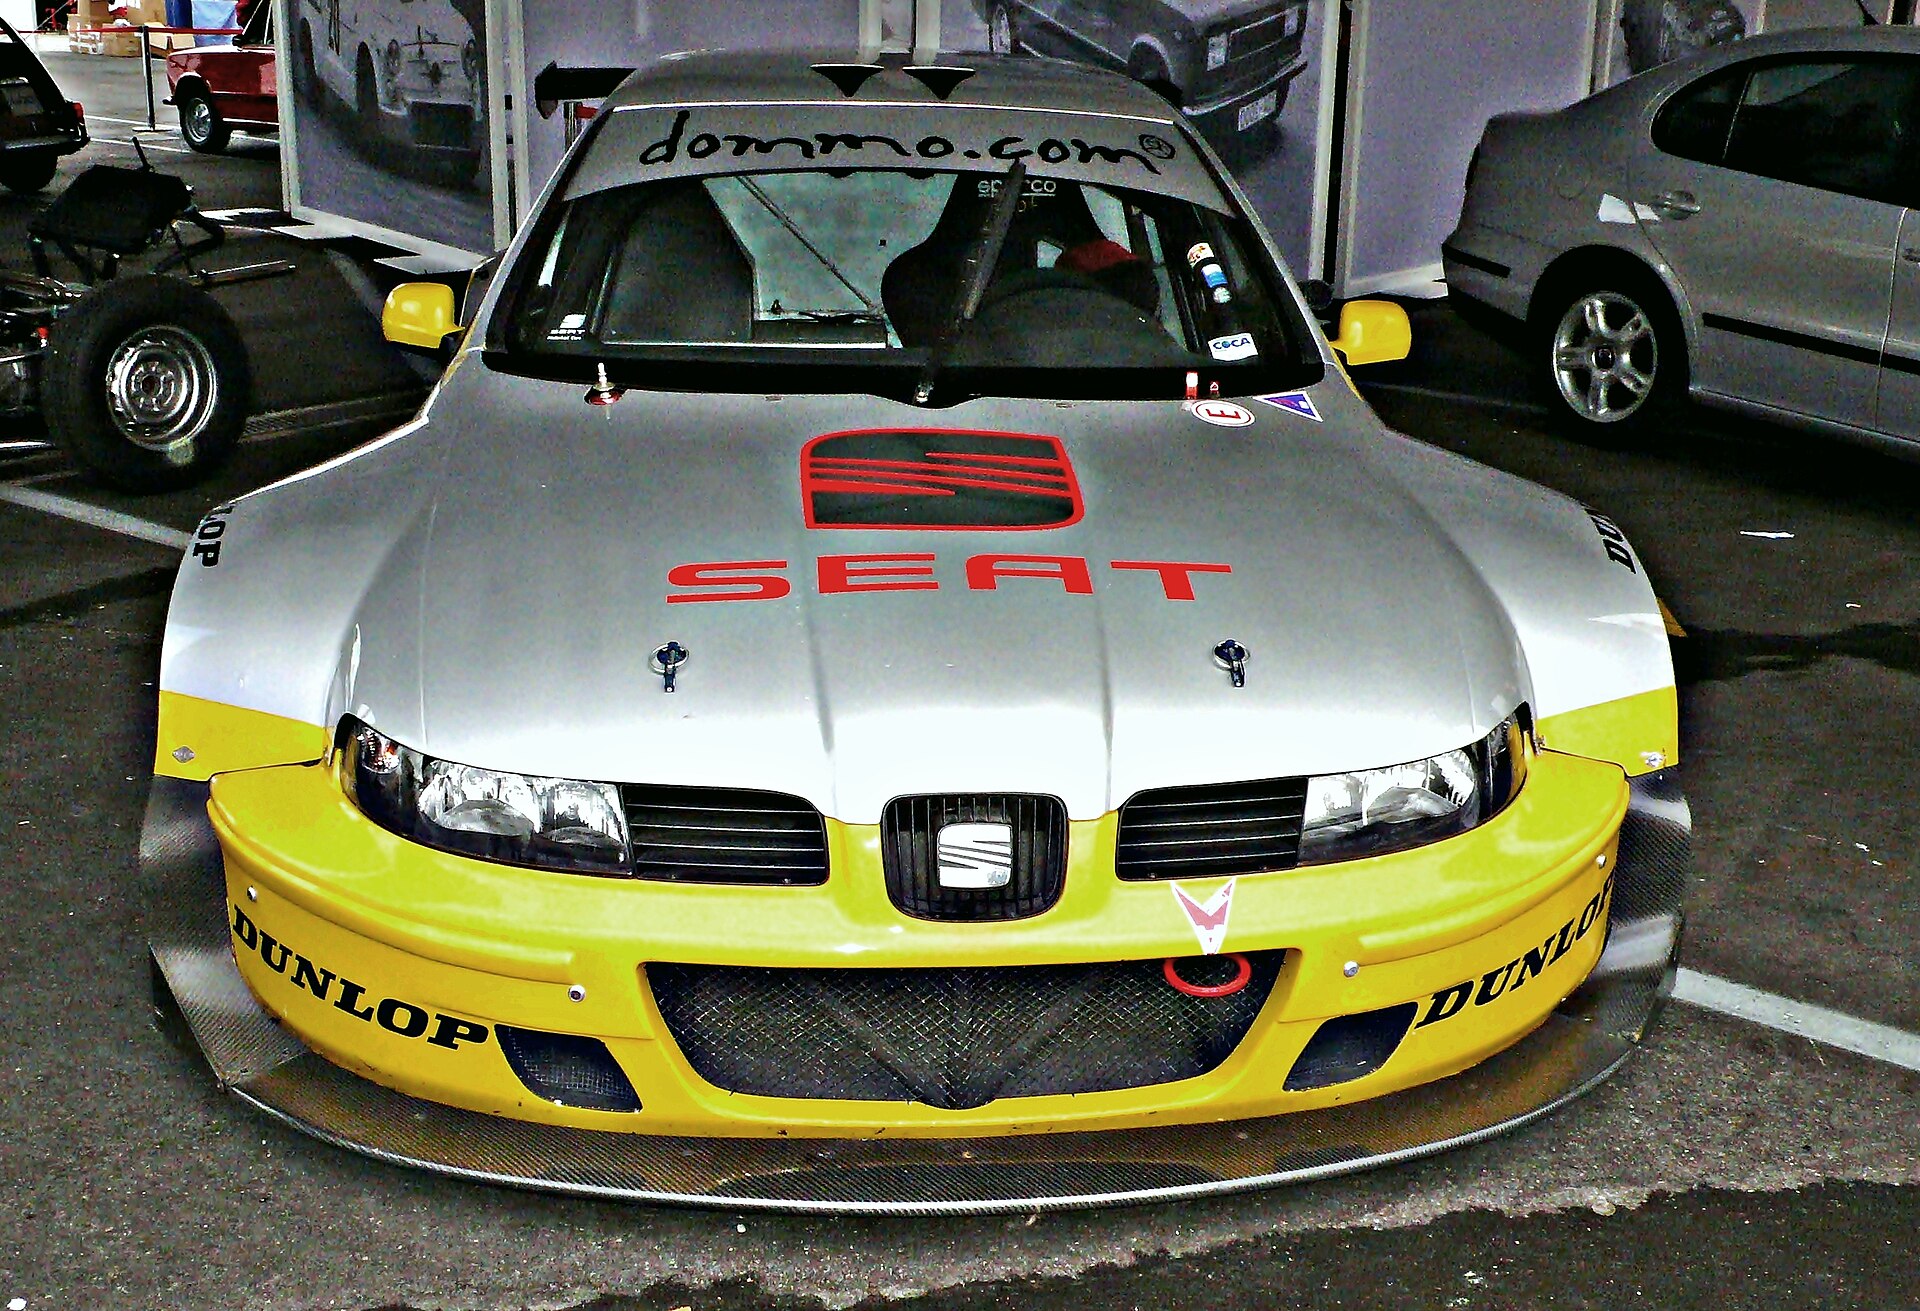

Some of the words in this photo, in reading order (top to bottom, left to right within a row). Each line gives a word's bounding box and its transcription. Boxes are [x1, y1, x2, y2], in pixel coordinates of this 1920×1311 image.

[977, 179, 1057, 198] spco
[1212, 337, 1251, 350] COCA
[1205, 408, 1242, 420] E
[193, 505, 235, 567] LOP
[666, 552, 1233, 604] SEAT
[1414, 866, 1616, 1030] DUNLOP
[232, 903, 490, 1051] DUNLOP
